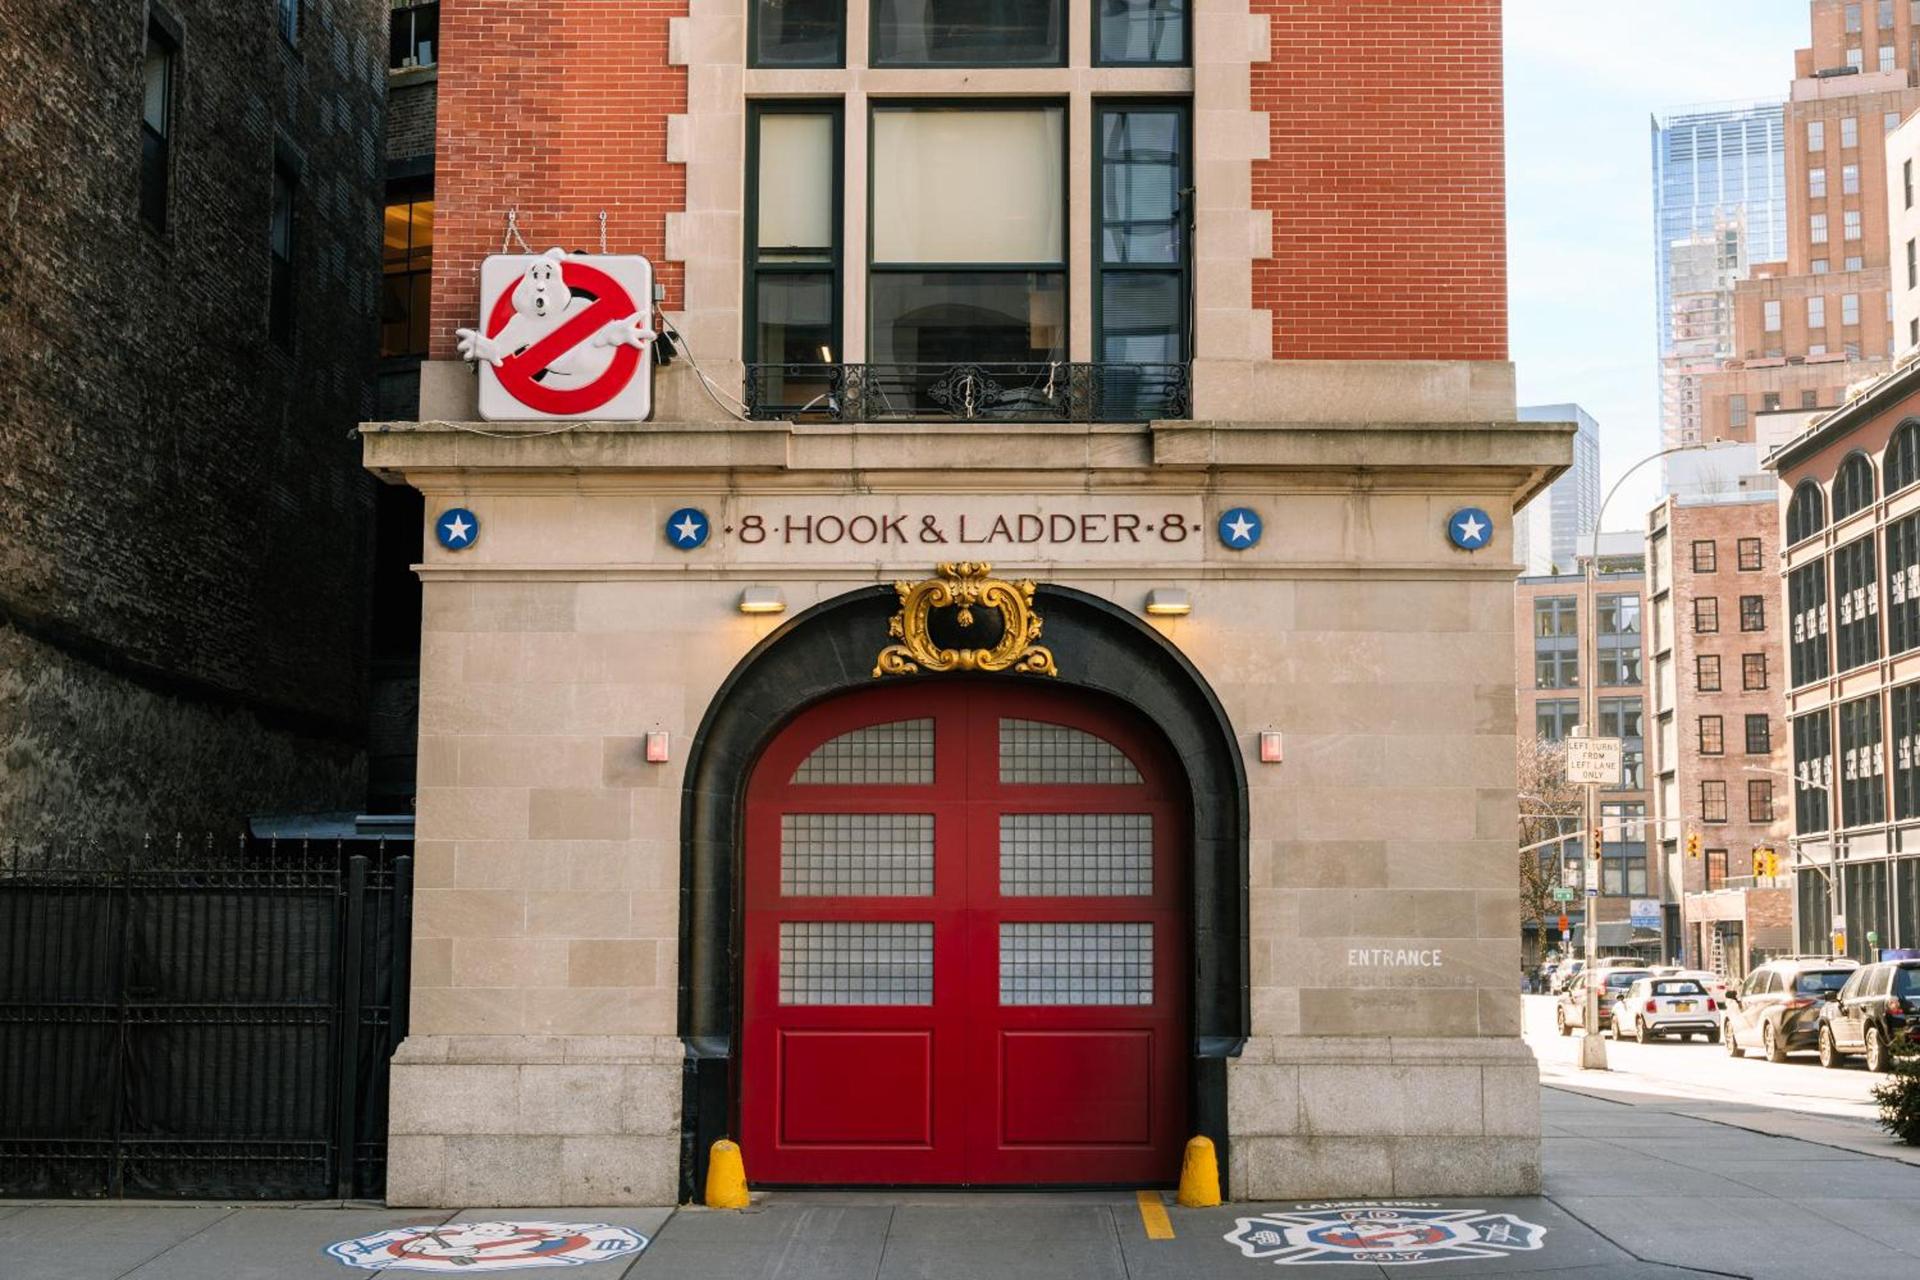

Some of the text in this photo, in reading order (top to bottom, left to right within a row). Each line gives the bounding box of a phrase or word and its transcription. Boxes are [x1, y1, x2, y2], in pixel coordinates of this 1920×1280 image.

[739, 513, 1188, 544] 8 HOOK & LADDER 8
[1568, 741, 1619, 751] LEFT TURNS
[1582, 751, 1605, 760] FROM
[1571, 760, 1616, 770] LEFT LANE
[1583, 770, 1604, 779] ONLY
[1347, 948, 1443, 967] ENTRANCE
[1295, 1201, 1380, 1210] LADDER
